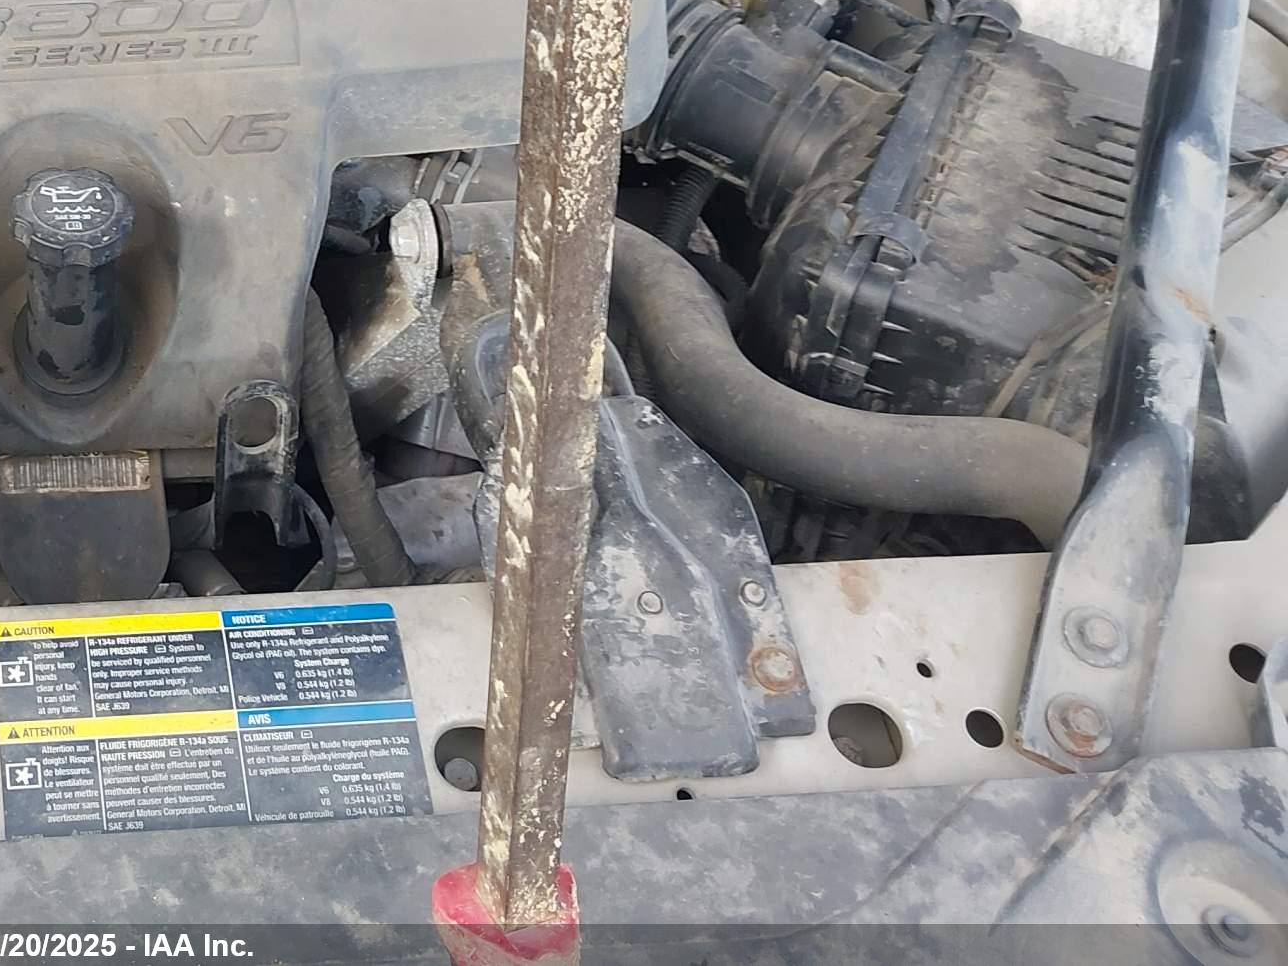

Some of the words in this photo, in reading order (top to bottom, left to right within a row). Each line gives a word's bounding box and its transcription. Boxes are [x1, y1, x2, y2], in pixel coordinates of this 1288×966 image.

[2, 37, 187, 70] SERIES
[164, 112, 292, 156] V6
[231, 614, 266, 624] NOTICE
[14, 626, 55, 636] CAUTION
[228, 631, 242, 639] AIR
[242, 628, 296, 638] CONDITIONING
[42, 640, 58, 649] help
[59, 639, 78, 648] avoid
[116, 635, 166, 645] REFRIGERANT
[167, 633, 194, 642] UNDER
[229, 641, 244, 650] Use
[245, 640, 260, 649] only
[261, 639, 288, 648] R-134a
[289, 636, 328, 647] Refrigerant
[329, 635, 344, 645] and
[344, 633, 390, 644] Polyalkylene
[33, 651, 64, 660] personal
[90, 648, 108, 657] HIGH
[109, 646, 148, 656] PRESSURE
[167, 643, 195, 652] System
[231, 651, 254, 661] Glycol
[254, 651, 264, 660] oil
[264, 650, 282, 659] (PAG
[298, 648, 312, 657] The
[312, 647, 339, 656] system
[339, 645, 370, 655] contains
[57, 661, 75, 669] keep
[101, 658, 132, 667] serviced
[143, 655, 174, 665] qualified
[175, 653, 211, 663] personnel
[293, 658, 321, 668] System
[322, 657, 350, 666] Charge
[110, 668, 143, 678] Improper
[143, 666, 170, 676] service
[171, 664, 202, 674] methods
[294, 669, 316, 679] 0.635
[35, 673, 57, 681] hands
[36, 684, 53, 692] clear
[93, 681, 109, 690] may
[110, 680, 132, 689] cause
[132, 678, 164, 688] personal
[296, 680, 318, 690] 0.544
[43, 695, 57, 703] can
[58, 694, 75, 702] start
[94, 691, 121, 701] General
[122, 689, 148, 699] Motors
[237, 694, 261, 704] Police
[261, 693, 288, 702] Vehicle
[298, 691, 319, 700] 0.544
[47, 705, 60, 714] any
[61, 704, 80, 713] time.
[95, 702, 110, 711] SAE
[111, 701, 130, 710] J639
[246, 713, 271, 724] AVIS
[22, 725, 75, 737] ATTENTION
[242, 731, 294, 742] CLIMATISEUR
[99, 739, 127, 750] FLUIDE
[178, 735, 206, 746] R-134a
[207, 733, 228, 744] SOUS
[244, 744, 271, 754] Utiliser
[272, 741, 310, 752] seulement
[319, 740, 341, 749] fluide
[381, 735, 410, 746] R-134a
[41, 744, 74, 754] Attention
[76, 743, 89, 752] aux
[368, 748, 390, 758] (huile
[69, 754, 94, 765] Risque
[100, 752, 126, 762] HAUTE
[127, 750, 165, 760] PRESSION
[134, 762, 149, 772] doit
[197, 758, 211, 768] par
[290, 764, 322, 774] contient
[55, 777, 94, 787] ventilateur
[102, 774, 140, 785] personnel
[211, 769, 226, 779] Des
[331, 772, 360, 783] Charge
[183, 781, 225, 791] incorrectes
[341, 784, 363, 794] 0.635
[45, 791, 62, 800] peut
[74, 789, 99, 798] mettre
[343, 795, 365, 805] 0.544
[52, 802, 79, 811] tourner
[81, 800, 100, 809] sans
[105, 798, 135, 808] peuvent
[136, 796, 162, 806] causer
[163, 796, 177, 805] des
[106, 809, 135, 819] General
[136, 808, 162, 818] Motors
[298, 809, 334, 820] patrouille
[344, 806, 367, 817] 0.544
[107, 822, 123, 831] SAE
[124, 821, 143, 830] J639
